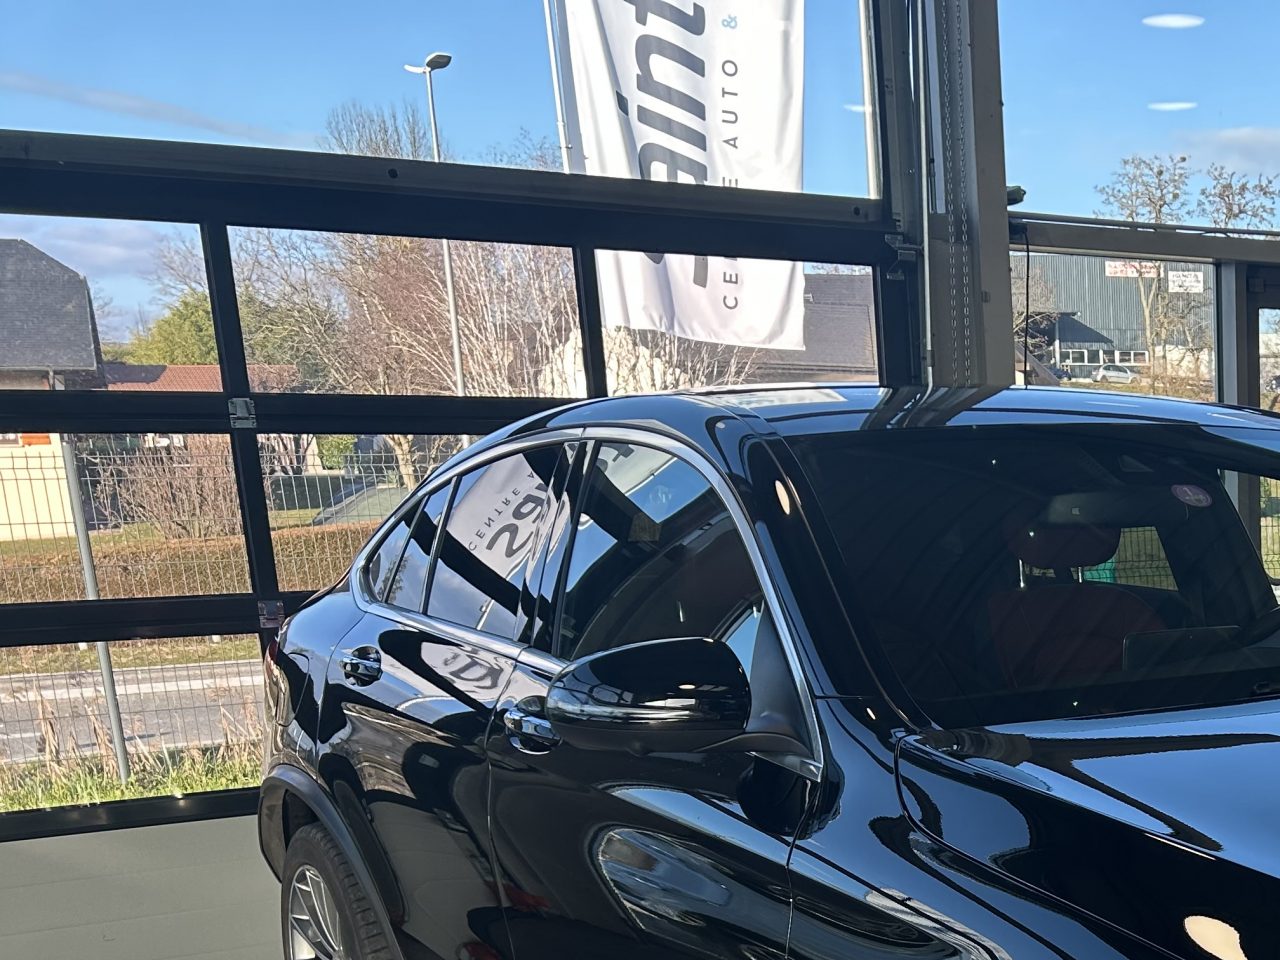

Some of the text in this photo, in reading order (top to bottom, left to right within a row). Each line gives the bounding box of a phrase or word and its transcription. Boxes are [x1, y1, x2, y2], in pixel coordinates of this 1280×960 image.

[722, 14, 738, 29] &
[616, 0, 708, 288] aint
[722, 60, 739, 149] AUTO
